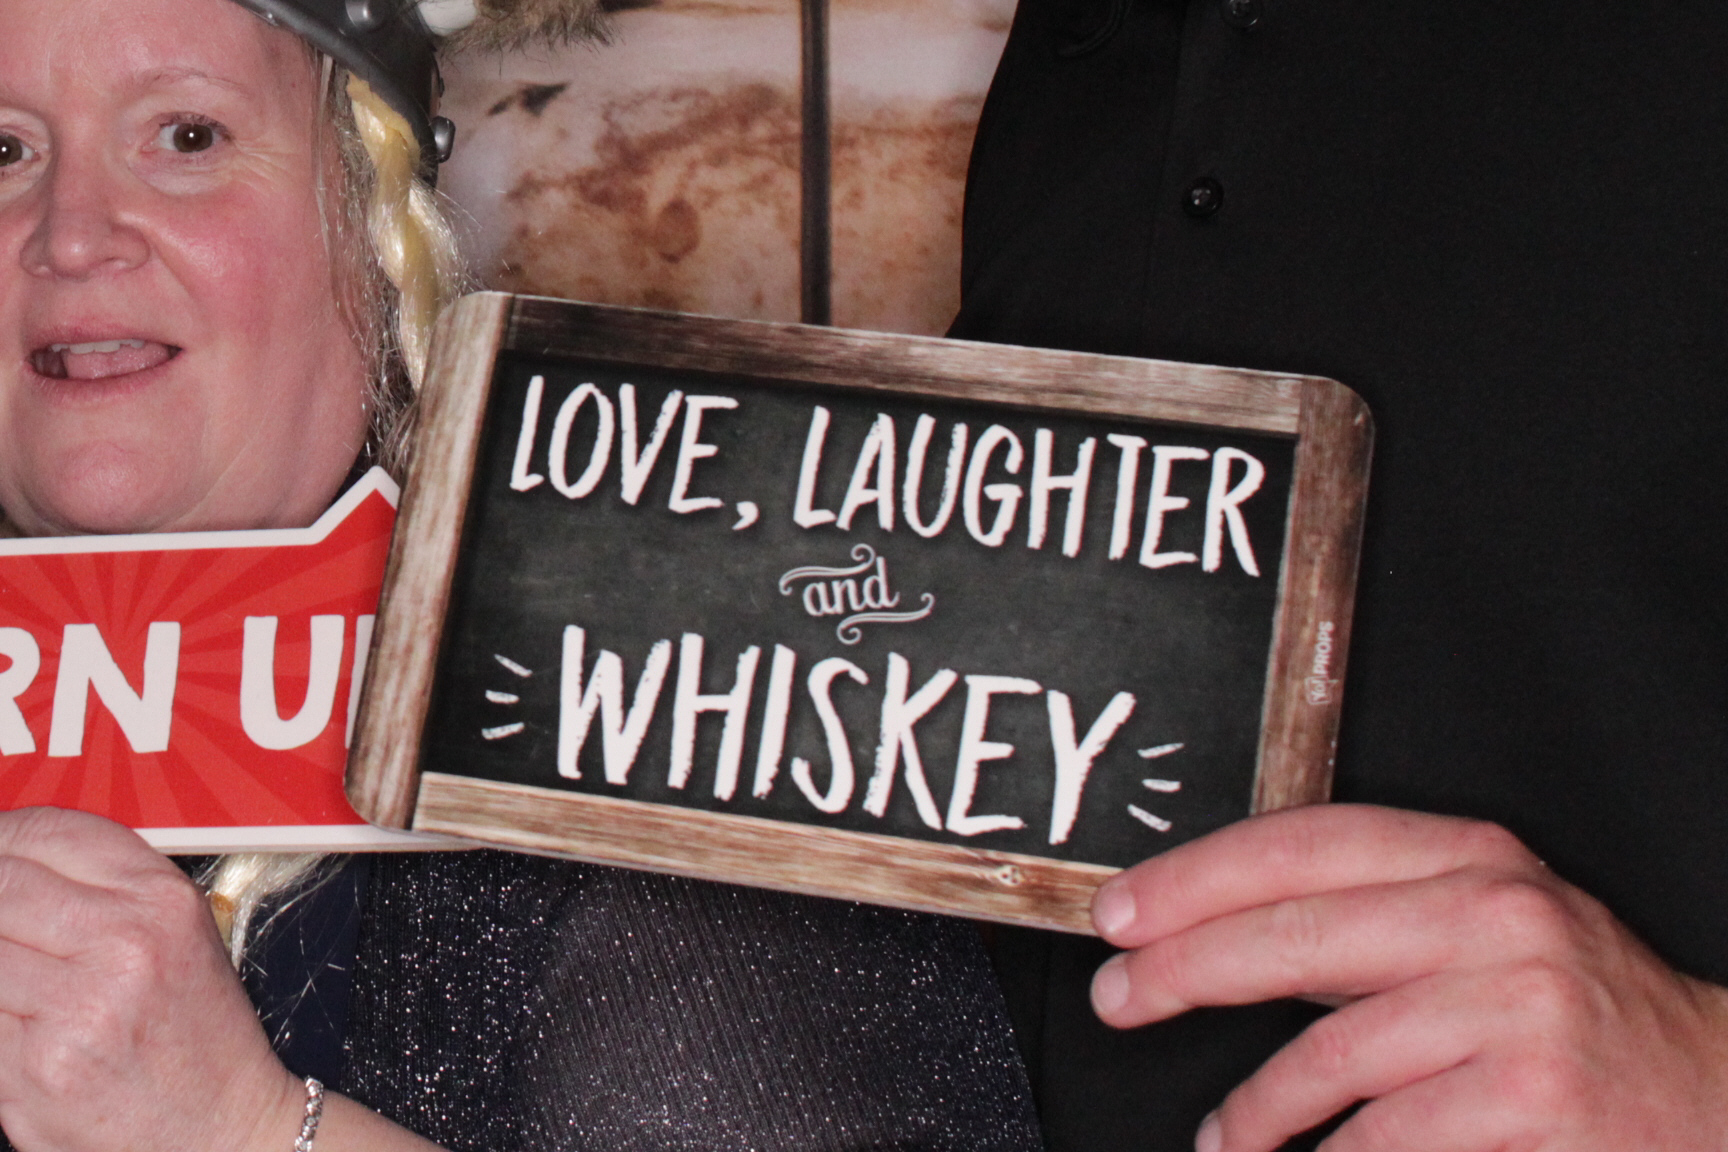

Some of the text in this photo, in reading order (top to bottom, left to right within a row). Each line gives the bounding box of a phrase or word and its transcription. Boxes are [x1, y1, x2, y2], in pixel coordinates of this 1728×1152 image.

[509, 375, 1264, 576] LOVE, LAUGHTER
[803, 557, 900, 616] and
[1313, 621, 1334, 675] PROPS
[240, 614, 375, 750] U
[557, 624, 1135, 844] WHISKEY
